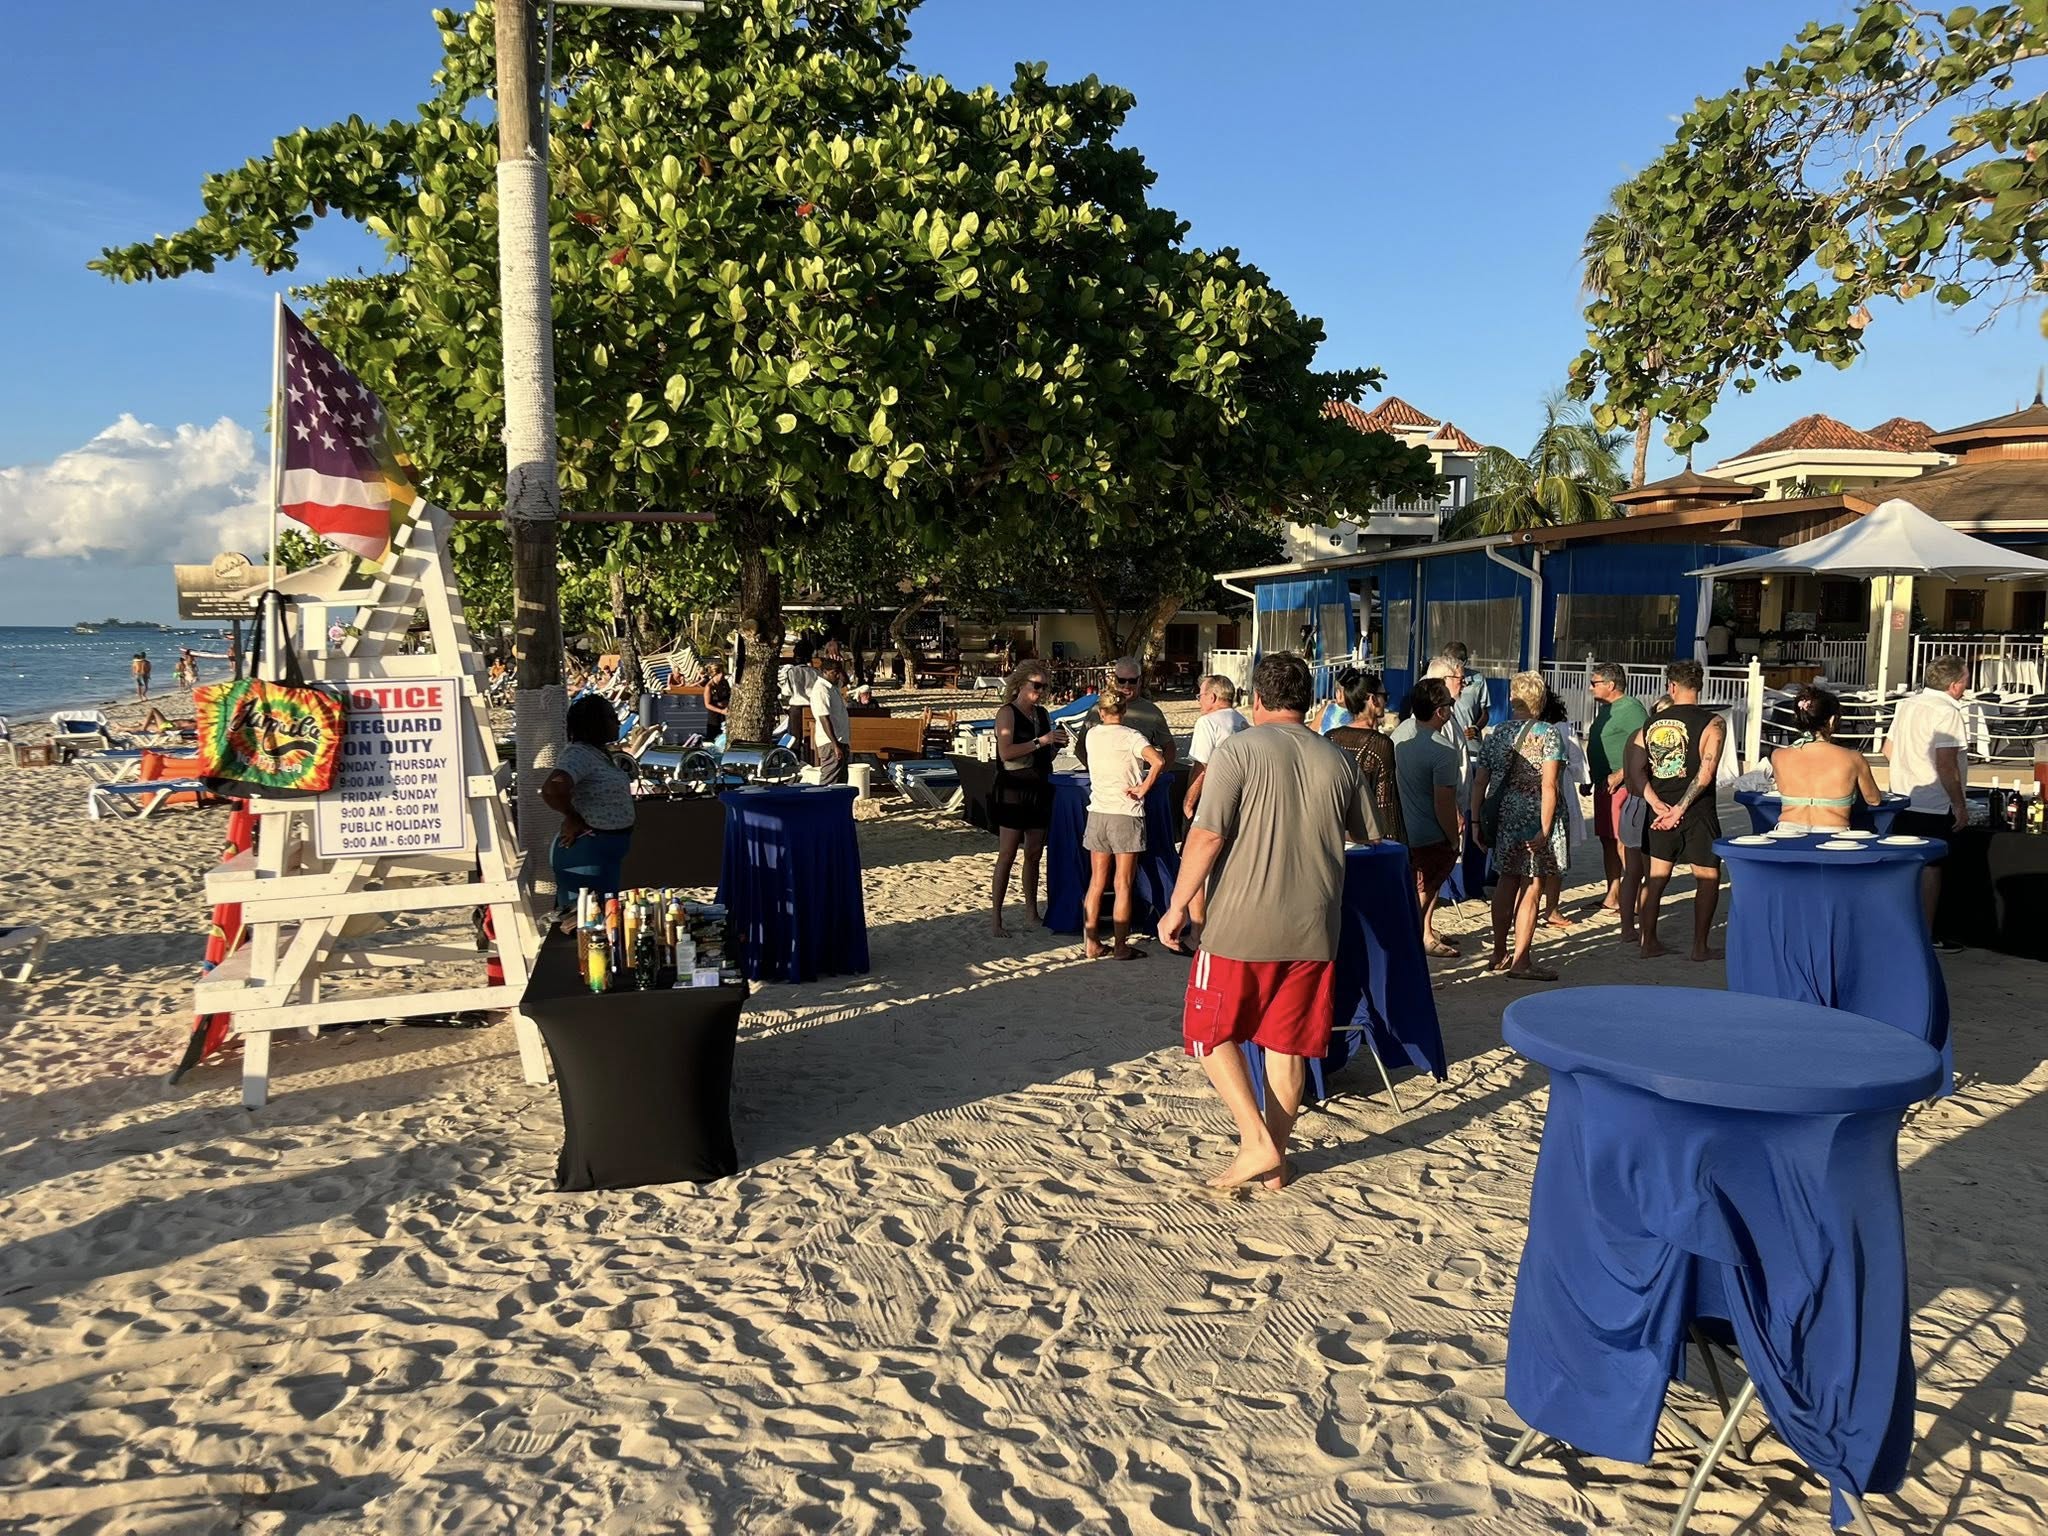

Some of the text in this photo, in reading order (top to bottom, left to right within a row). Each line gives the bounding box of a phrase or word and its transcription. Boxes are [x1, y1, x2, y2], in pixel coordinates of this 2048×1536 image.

[346, 687, 442, 709] OTICE
[343, 738, 432, 756] ON DUTY
[338, 760, 377, 773] ONDAY
[387, 758, 447, 771] THURSDAY
[340, 776, 363, 788] 9:00
[367, 775, 385, 787] AM
[394, 774, 418, 786] 5:00
[421, 773, 438, 785] PM
[341, 791, 382, 803] FRIDAY
[392, 788, 437, 801] SUNDAY
[341, 807, 365, 818] 9:00
[369, 806, 386, 817] AM
[396, 804, 419, 816] 6:00
[422, 803, 439, 815] PM
[340, 818, 442, 834] PUBLIC HOLIDAYS
[343, 838, 367, 849] 9:00
[370, 836, 387, 848] AM
[397, 835, 421, 846] 6:00
[424, 833, 441, 845] PM
